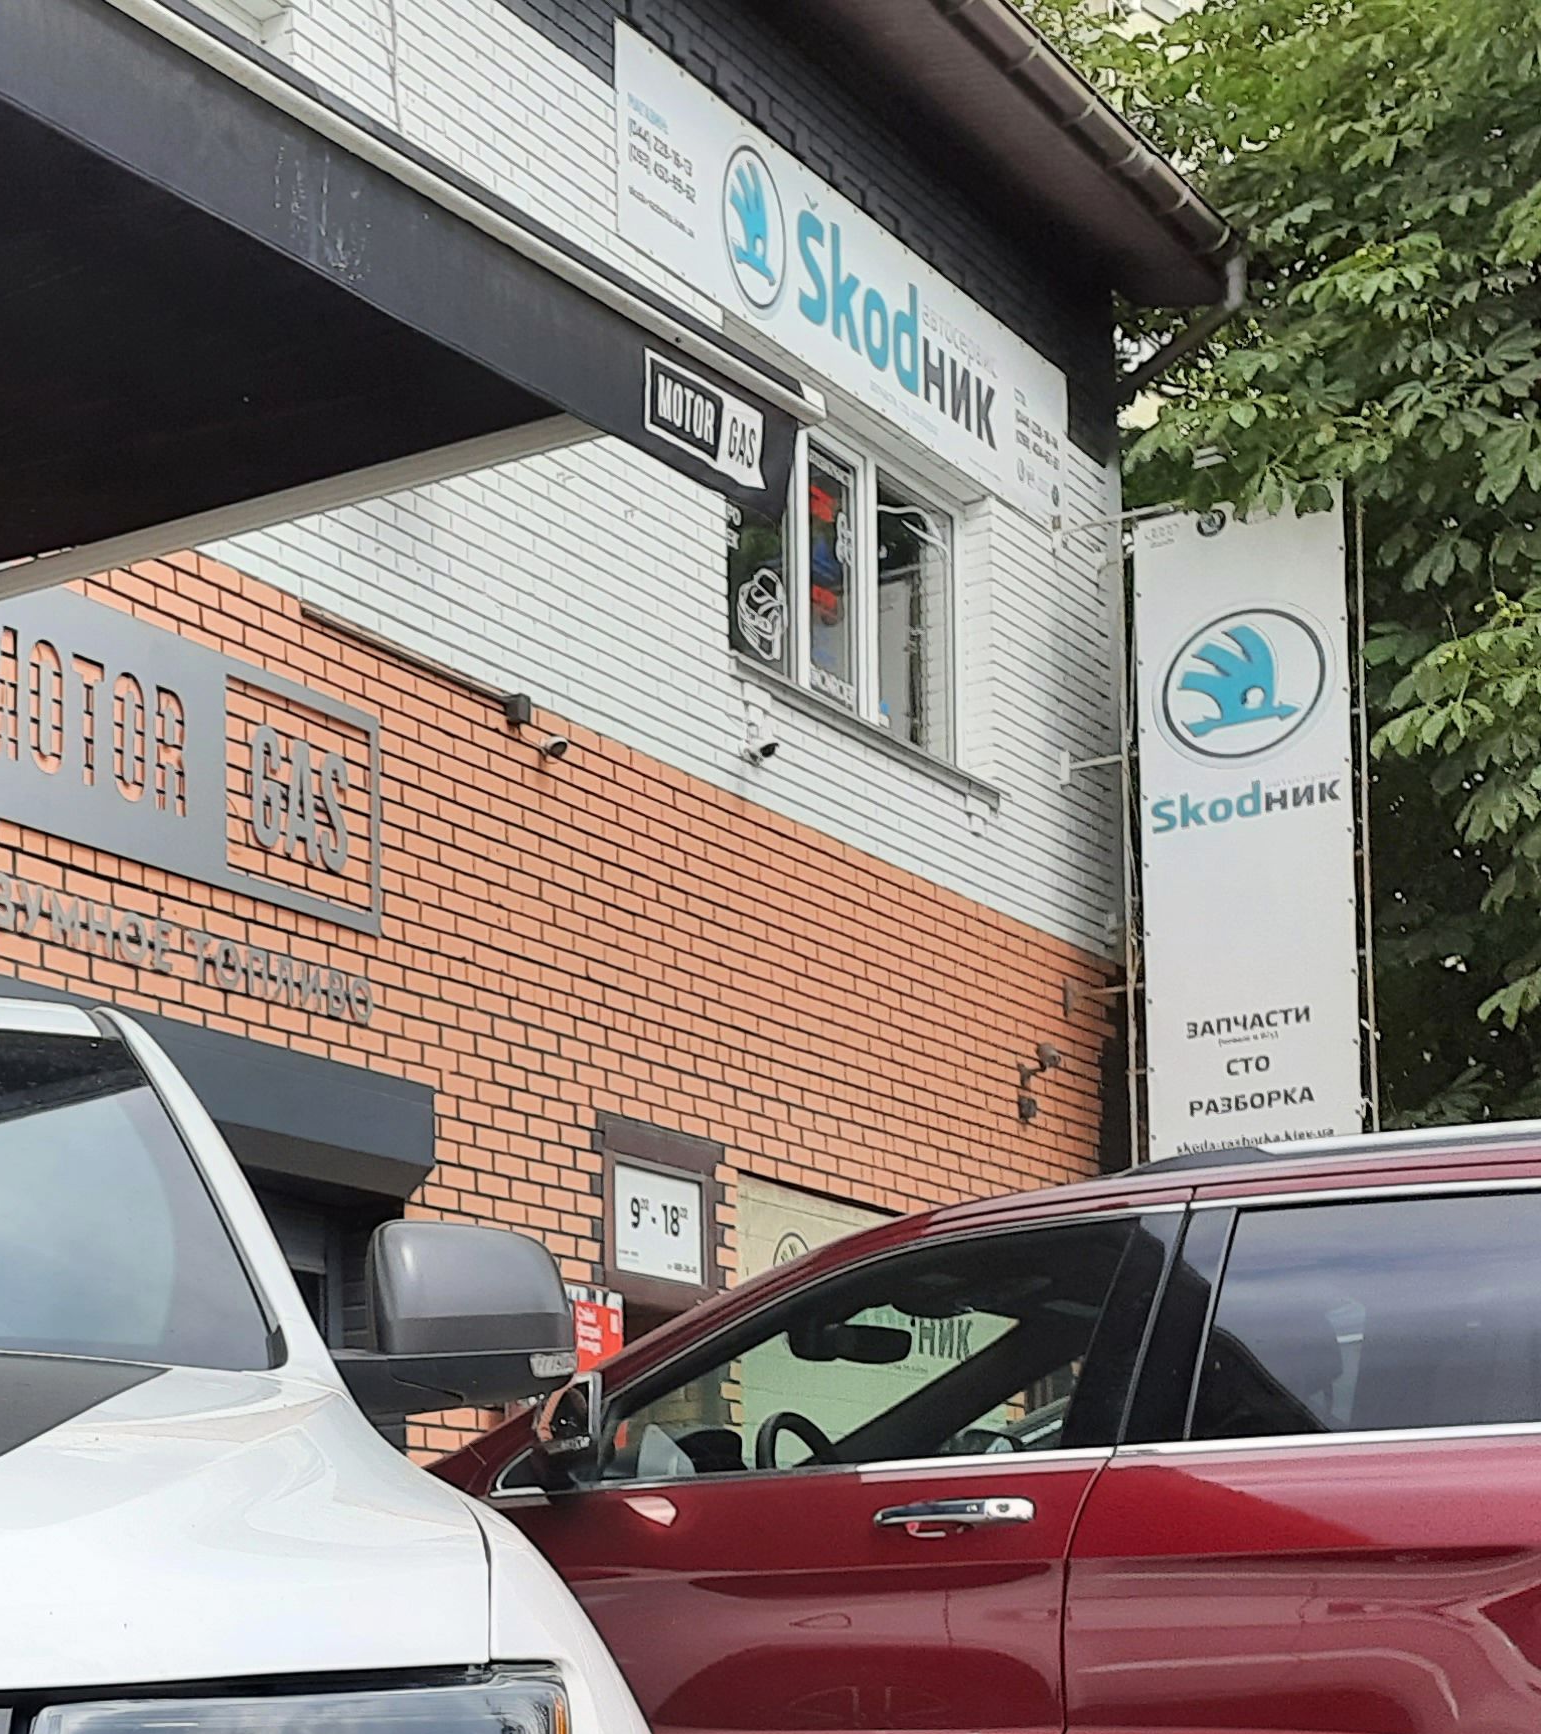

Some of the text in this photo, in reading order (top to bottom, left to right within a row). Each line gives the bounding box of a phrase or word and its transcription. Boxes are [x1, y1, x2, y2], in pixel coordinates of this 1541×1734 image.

[657, 371, 716, 446] MOTOR
[728, 416, 757, 469] GAS
[250, 723, 349, 876] GAS
[188, 929, 374, 1027] ТОПЛИВО
[1186, 1005, 1312, 1039] ЗАПЧАСТИ
[1226, 1055, 1271, 1077] СТО
[1188, 1086, 1316, 1118] РАЗБОРКА
